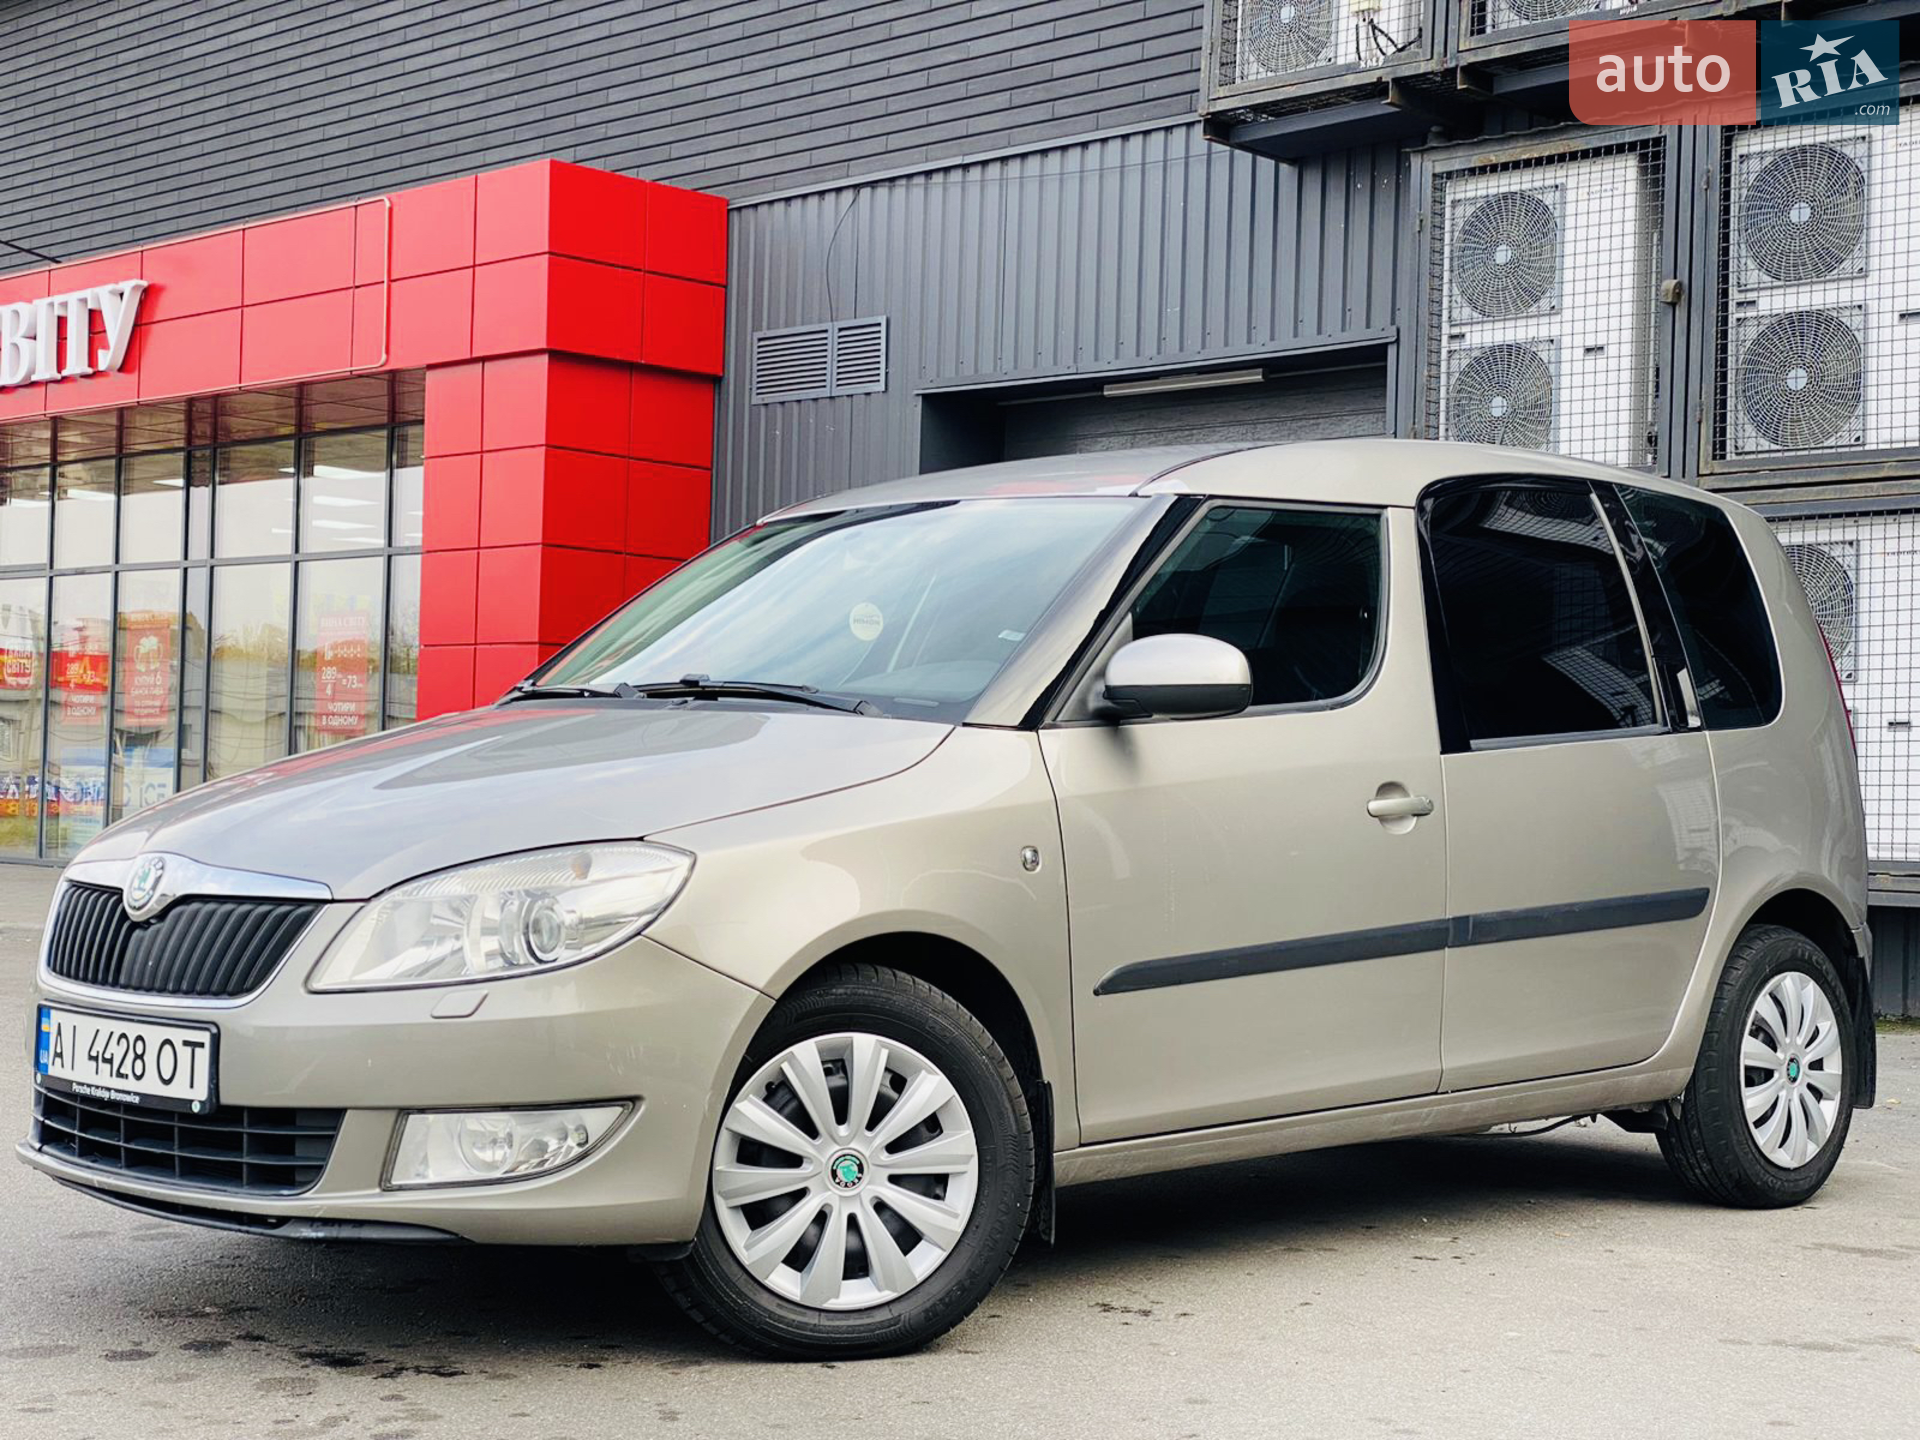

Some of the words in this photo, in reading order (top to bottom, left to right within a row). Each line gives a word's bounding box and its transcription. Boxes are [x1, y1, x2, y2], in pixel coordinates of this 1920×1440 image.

[52, 1021, 77, 1072] AI
[88, 1028, 146, 1082] 4428
[157, 1038, 205, 1090] OT
